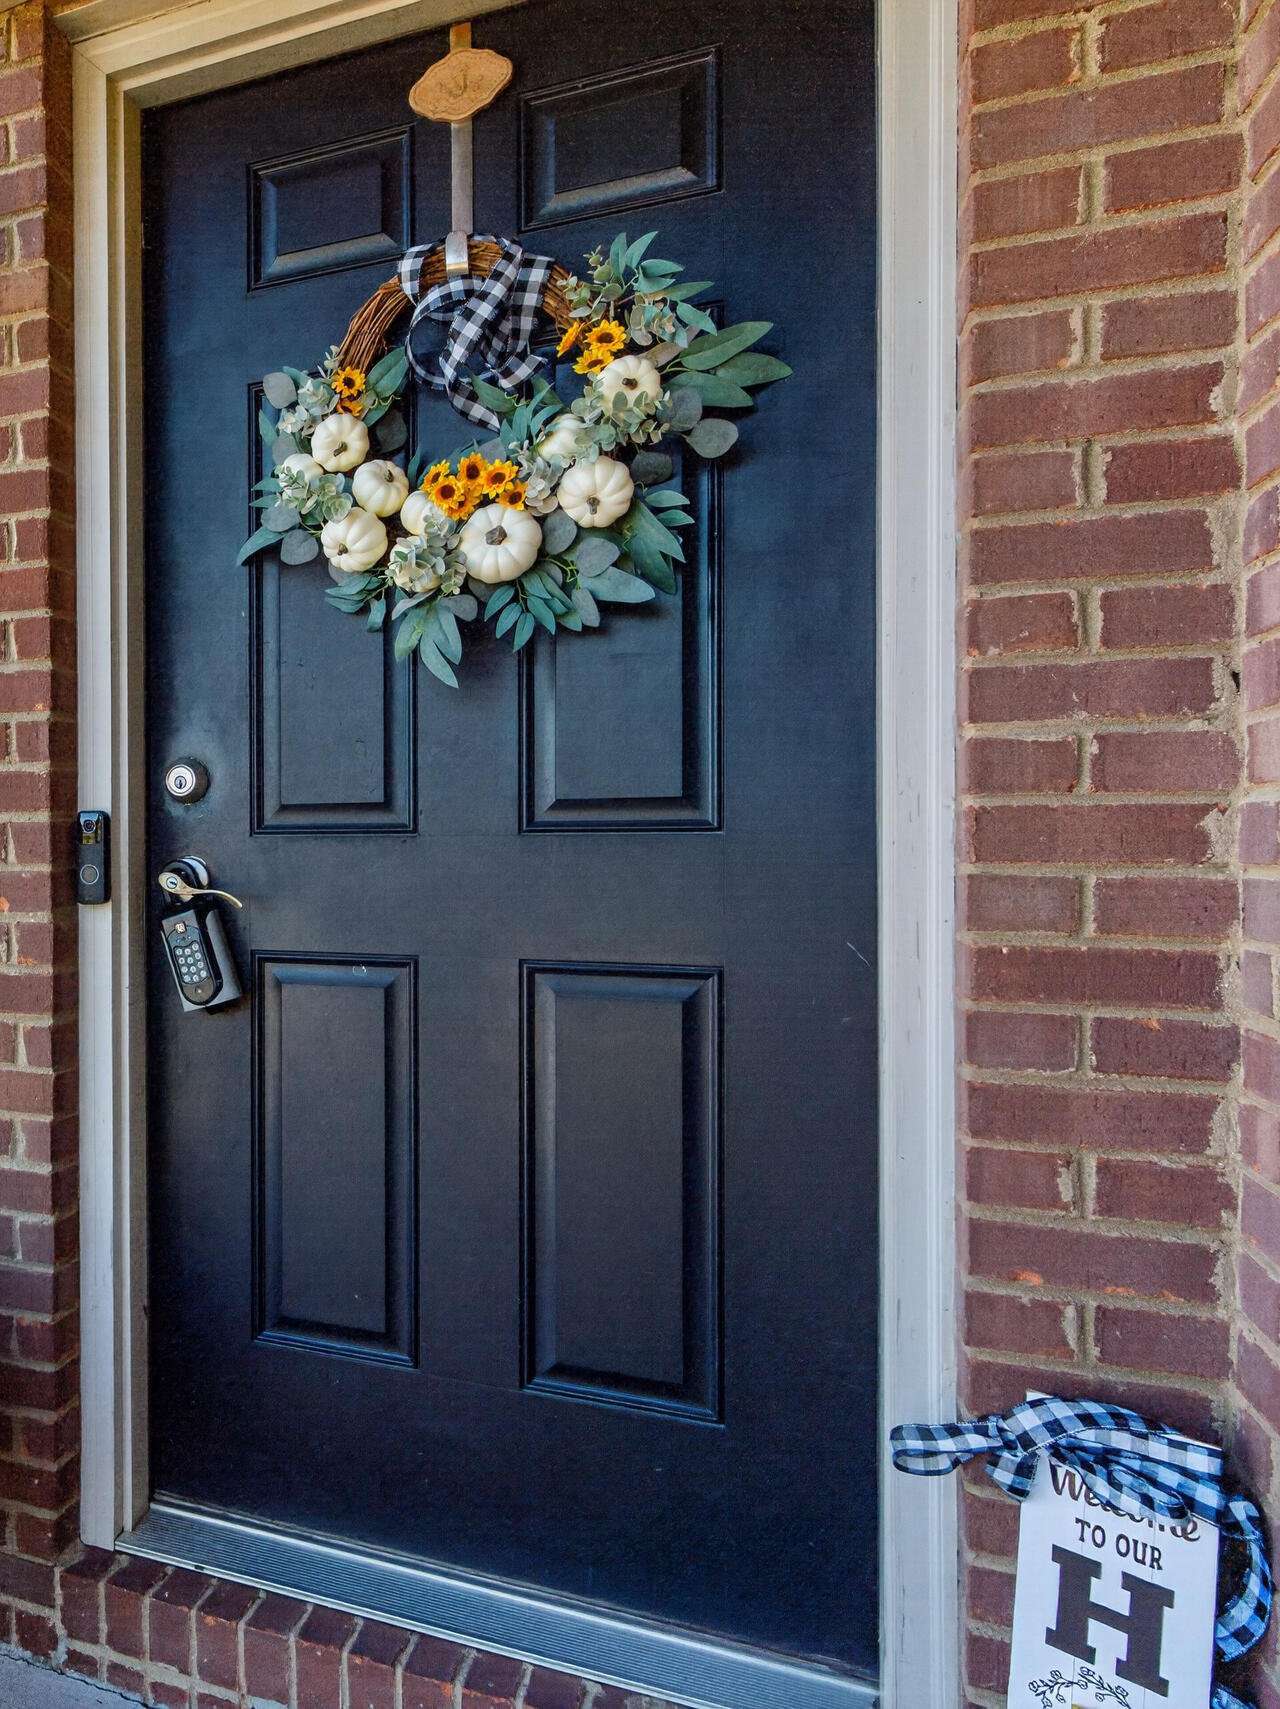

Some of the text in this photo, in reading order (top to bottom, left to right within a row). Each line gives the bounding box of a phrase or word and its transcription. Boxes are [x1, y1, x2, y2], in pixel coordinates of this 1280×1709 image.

[1074, 1517, 1163, 1571] TO OUR
[1045, 1544, 1175, 1697] H
